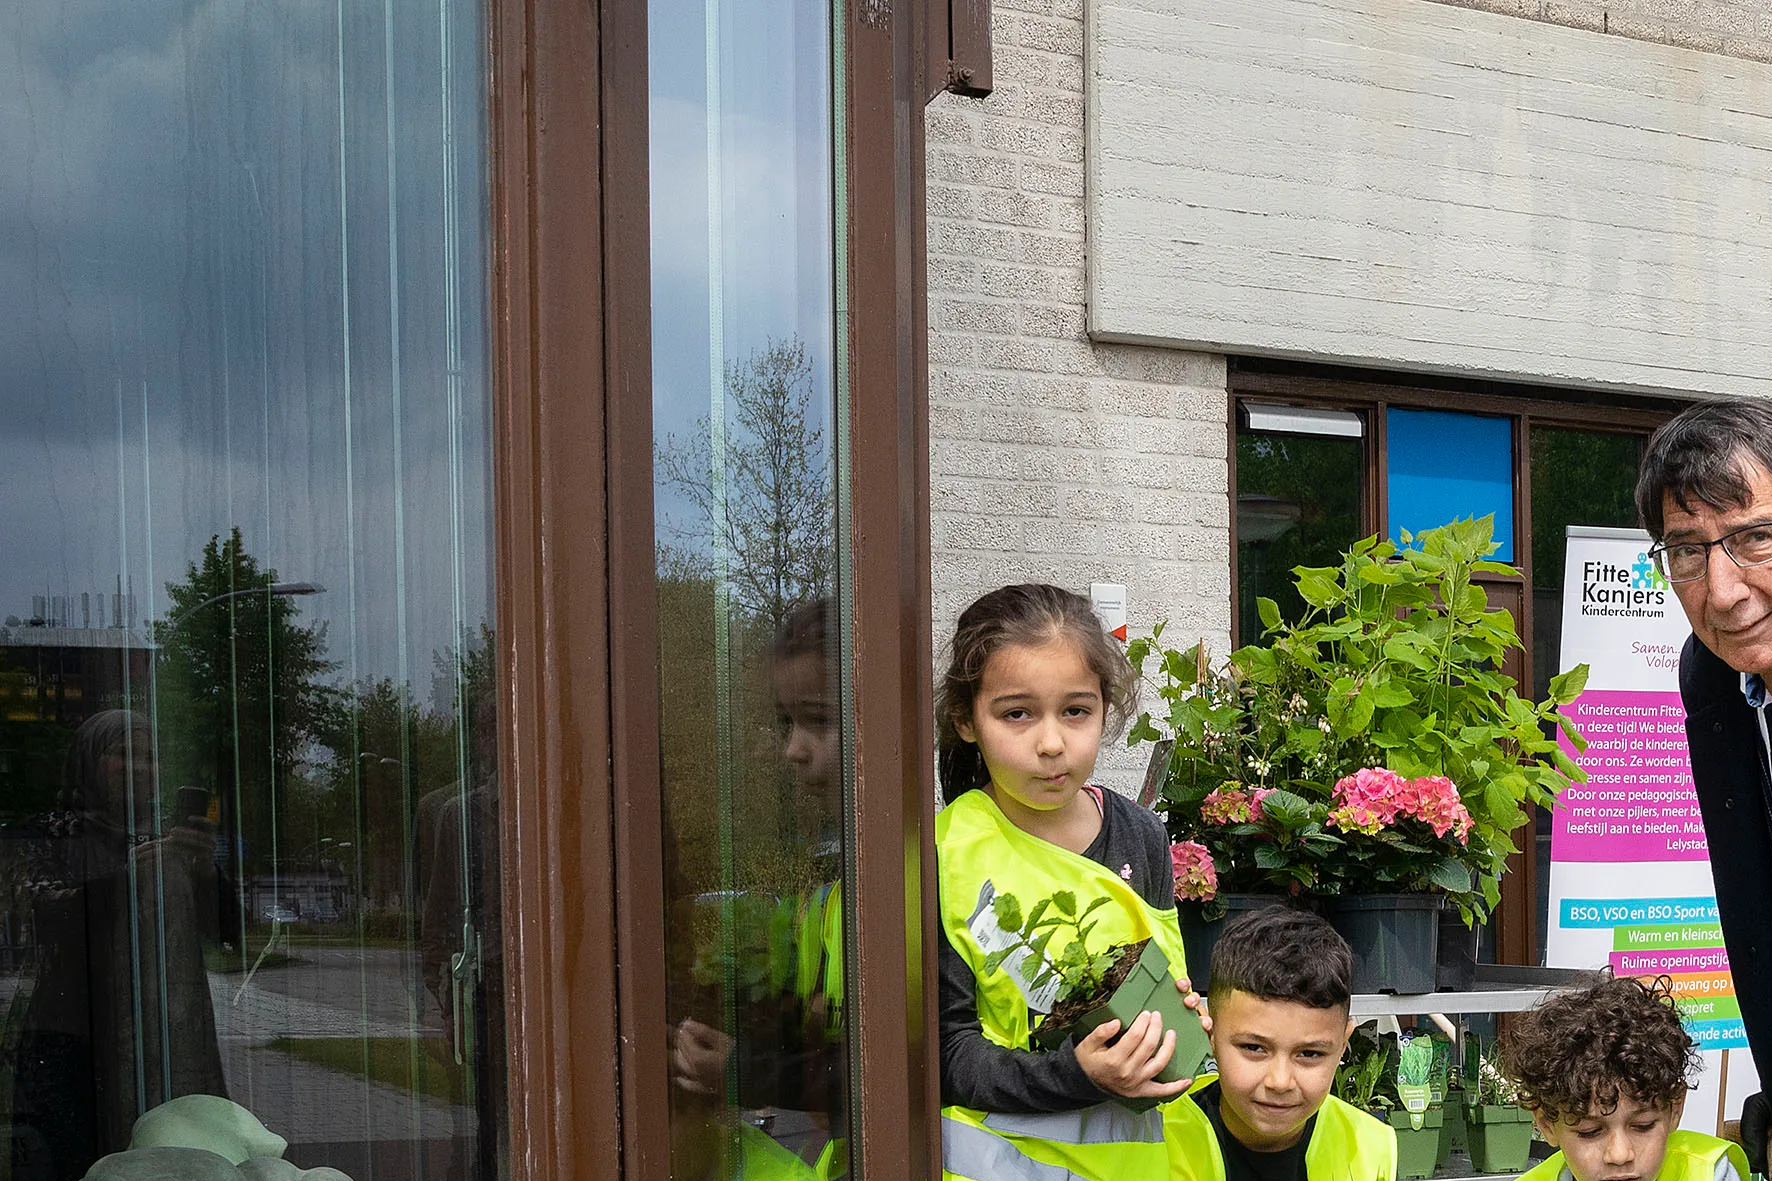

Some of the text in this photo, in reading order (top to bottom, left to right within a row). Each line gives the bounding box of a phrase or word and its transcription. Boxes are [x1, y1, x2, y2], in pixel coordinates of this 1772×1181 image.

[1583, 561, 1630, 583] Fitte
[1581, 583, 1665, 609] Kanjers
[1581, 604, 1664, 618] Kindercentrum
[1577, 703, 1683, 718] Kindercentrum Fitte
[1587, 721, 1614, 733] deze
[1616, 722, 1637, 735] tijd!
[1639, 722, 1655, 733] We
[1586, 738, 1628, 752] waarbij
[1629, 739, 1644, 750] de
[1575, 755, 1603, 767] door
[1605, 758, 1628, 767] ons.
[1629, 755, 1643, 767] Ze
[1645, 757, 1684, 768] worden
[1586, 773, 1692, 786] eresse en samen zijn
[1567, 788, 1698, 803] Door onze pedagogische
[1572, 807, 1596, 817] met
[1598, 808, 1626, 817] onze
[1627, 806, 1660, 820] pijlers,
[1661, 808, 1688, 817] meer
[1567, 822, 1608, 836] leefstijl
[1609, 824, 1629, 834] aan
[1631, 823, 1641, 834] te
[1643, 823, 1682, 834] bieden.
[1570, 907, 1600, 922] BSO,
[1603, 907, 1628, 920] VSO
[1630, 909, 1645, 920] en
[1647, 906, 1672, 919] BSO
[1673, 905, 1704, 920] Sport
[1628, 931, 1662, 943] Warm
[1664, 931, 1679, 942] en
[1621, 956, 1658, 969] Ruime
[1712, 979, 1728, 990] op
